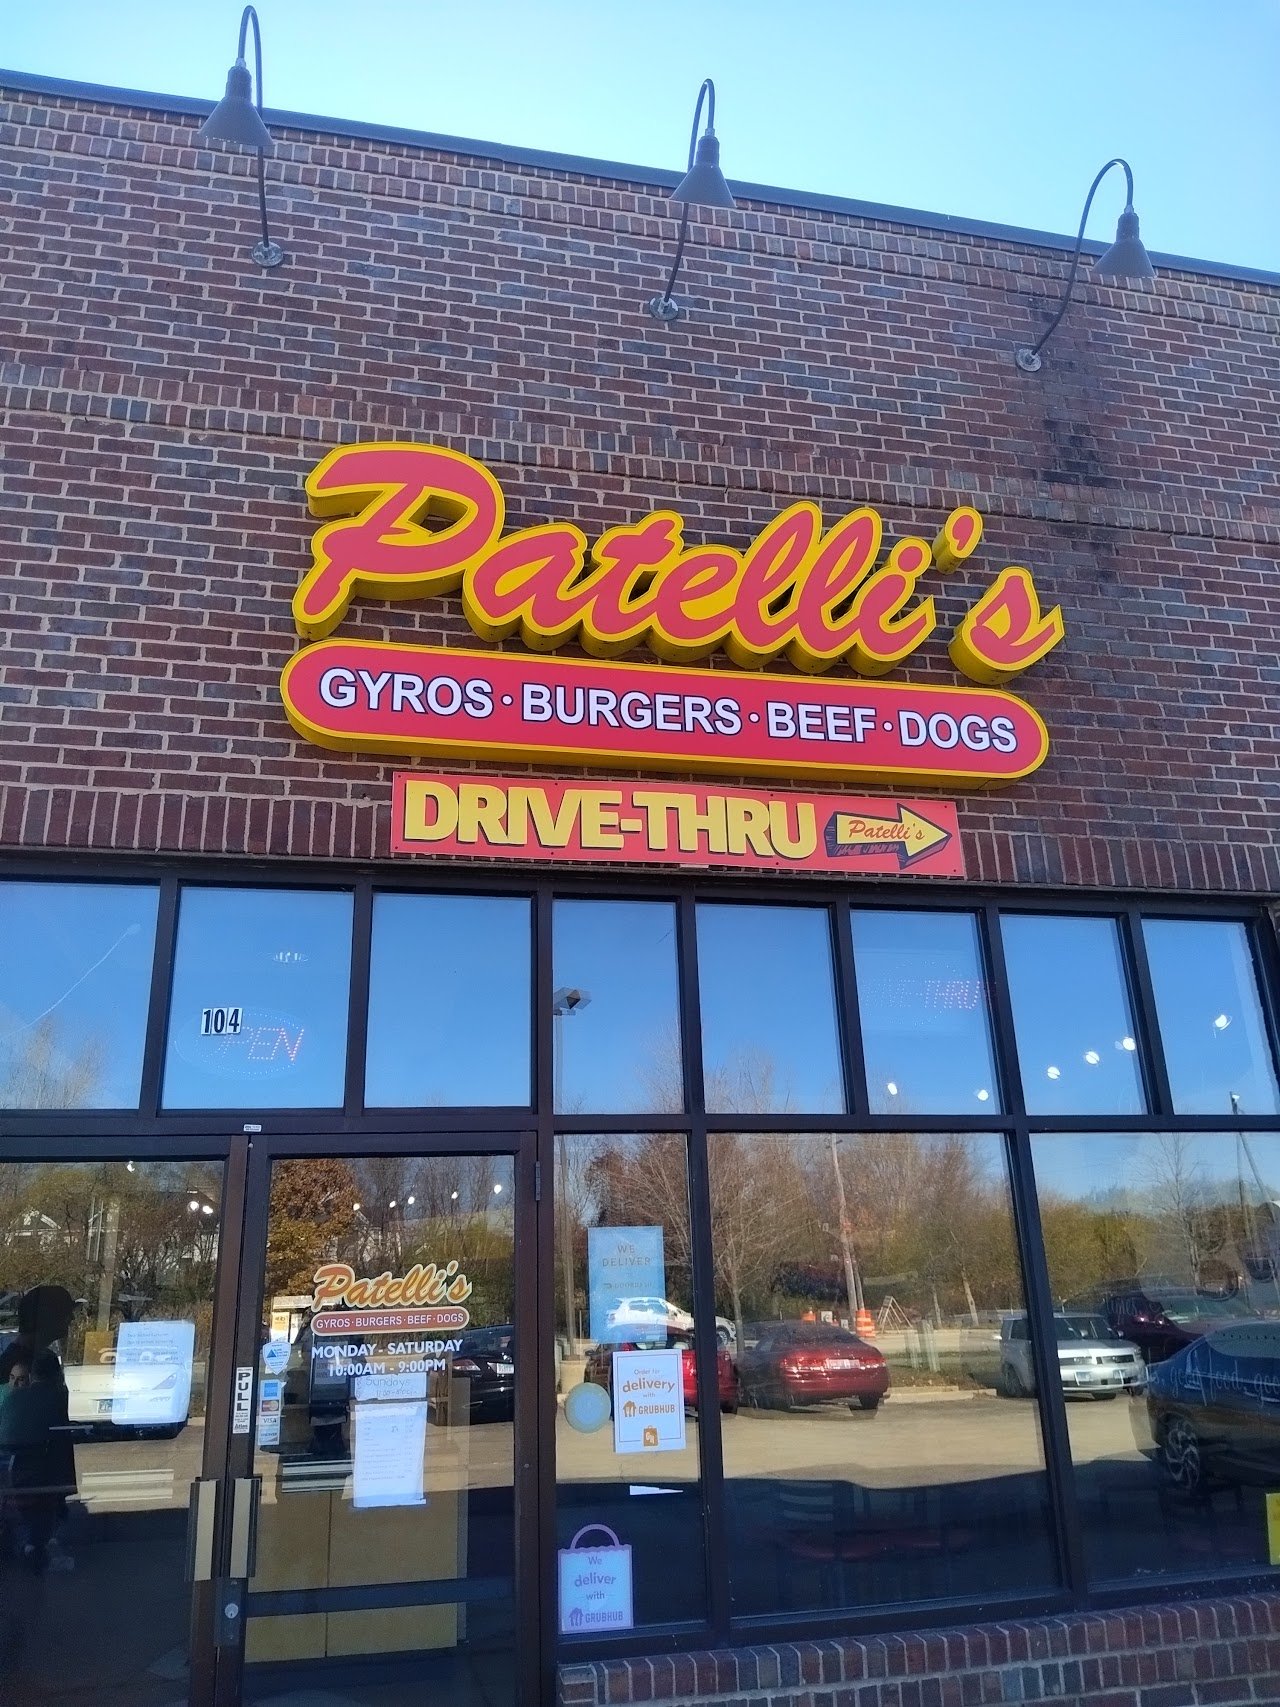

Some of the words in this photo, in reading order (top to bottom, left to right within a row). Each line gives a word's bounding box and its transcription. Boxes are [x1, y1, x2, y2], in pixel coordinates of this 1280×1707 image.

[294, 442, 1064, 671] Patelli's
[319, 666, 494, 718] GYROS
[521, 682, 742, 737] BURGERS
[766, 699, 876, 744] BEEF
[897, 709, 1018, 754] DOGS
[403, 780, 818, 860] DRIVE-THRU
[847, 819, 925, 841] Patelli's
[203, 1008, 241, 1034] 104
[617, 1244, 636, 1254] WE
[602, 1256, 651, 1267] DELIVER
[311, 1260, 473, 1313] Patelli's
[316, 1318, 350, 1329] GYROS
[355, 1315, 402, 1327] BURGERS
[407, 1313, 432, 1324] BEEF
[436, 1312, 464, 1323] DOGS
[311, 1343, 377, 1359] MONDAY
[387, 1338, 463, 1354] SATURDAY
[327, 1361, 386, 1377] 10:00AM
[398, 1358, 446, 1373] 9:00PM
[633, 1367, 650, 1375] Order
[236, 1372, 251, 1411] PULL
[622, 1377, 675, 1393] delivery
[638, 1404, 675, 1415] GRUBHUB
[588, 1555, 603, 1566] We
[574, 1571, 617, 1588] deliver
[586, 1590, 605, 1600] with
[585, 1610, 624, 1623] GRUBHUB
